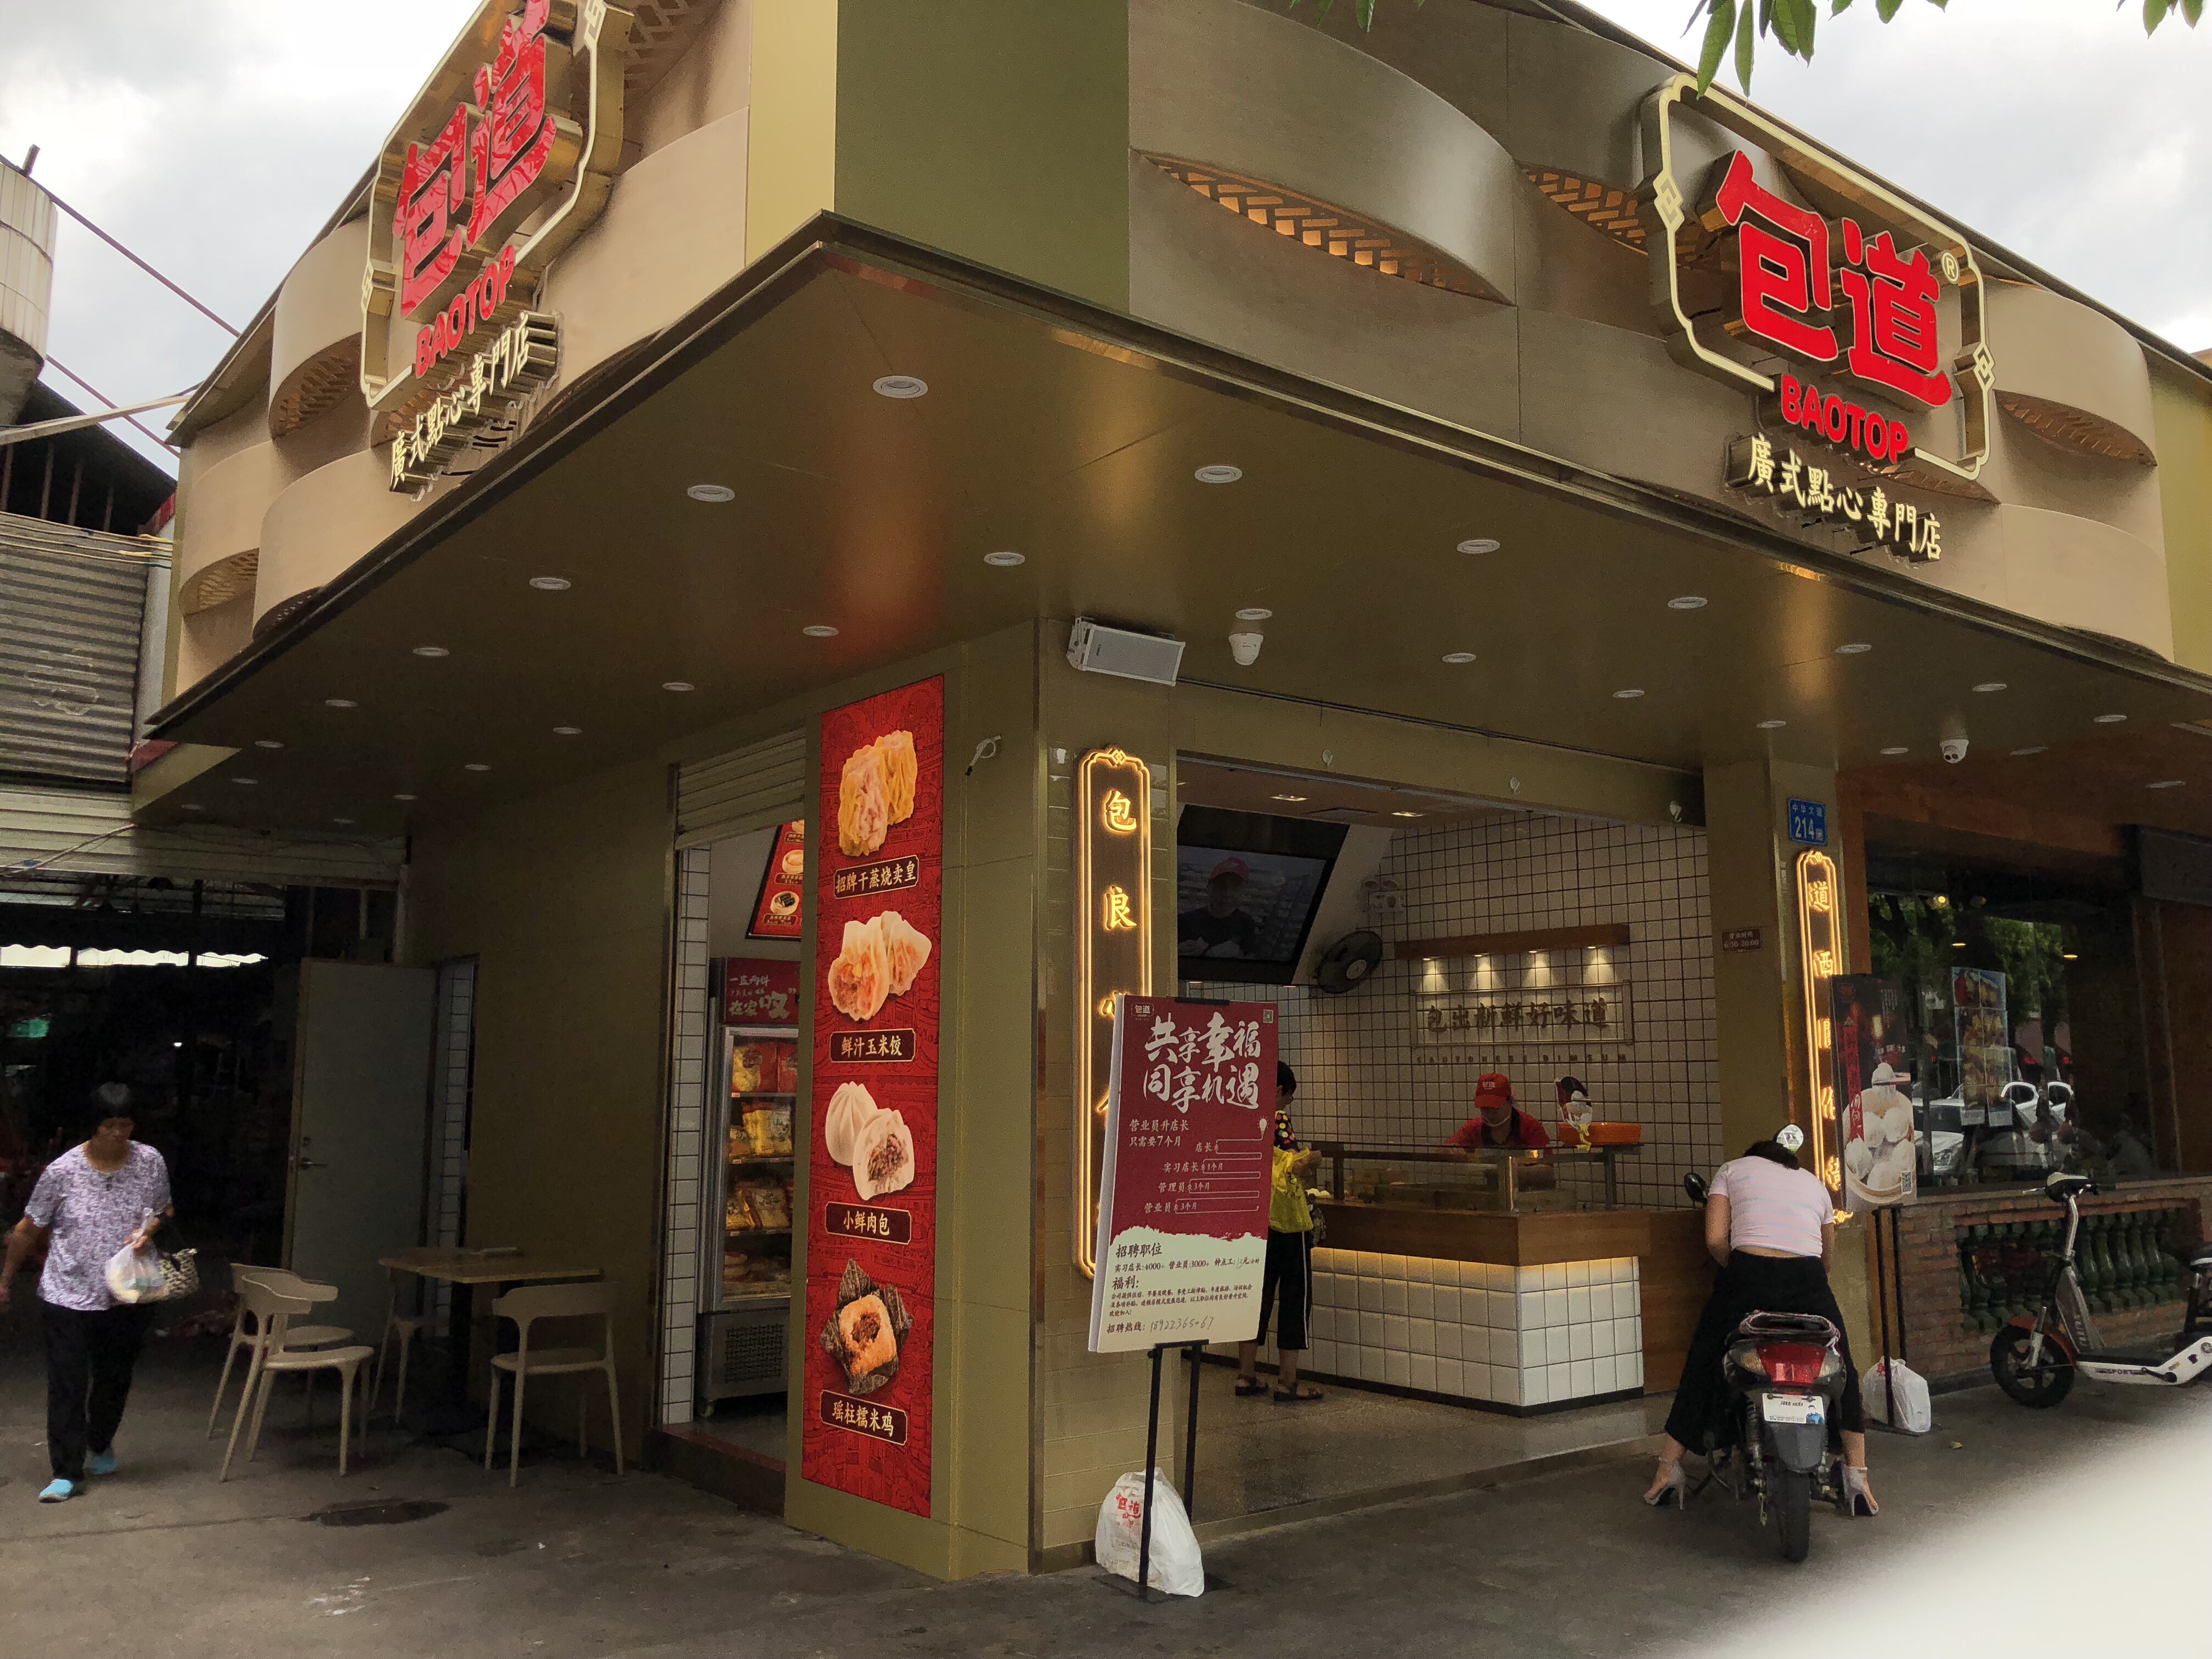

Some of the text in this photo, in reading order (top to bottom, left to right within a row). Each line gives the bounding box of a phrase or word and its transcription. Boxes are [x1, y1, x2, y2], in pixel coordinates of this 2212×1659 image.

[393, 0, 556, 318] 包道
[1717, 149, 1951, 407] 包道
[416, 245, 516, 379] BAOTOP
[390, 311, 529, 491] 廣式點心專門店
[1781, 374, 1909, 465] BAOTOP
[1748, 433, 1943, 561] 廣式點心專門店
[1792, 803, 1822, 817] 中华大道
[1795, 815, 1815, 840] 214
[836, 861, 917, 892] 招牌干蒸烧卖皇
[840, 1035, 903, 1058] 鲜汁玉米饺
[1144, 1012, 1261, 1073] 共享幸福
[1543, 1054, 1578, 1062] DIM
[1588, 1053, 1626, 1062] SUM
[1143, 1062, 1259, 1113] 同享机遇
[1129, 1119, 1189, 1132] 营业员升店长
[1129, 1135, 1181, 1148] 只需要7个月
[1195, 1142, 1212, 1153] 店长
[1164, 1161, 1223, 1173] 实习店长 1个月
[1158, 1182, 1211, 1193] 管理员 3个月
[1144, 1202, 1198, 1214] 营业员 3个月
[843, 1210, 890, 1235] 小鲜肉包
[1116, 1242, 1163, 1259] 招聘职位
[831, 1400, 894, 1437] 瑶柱糯米鸡
